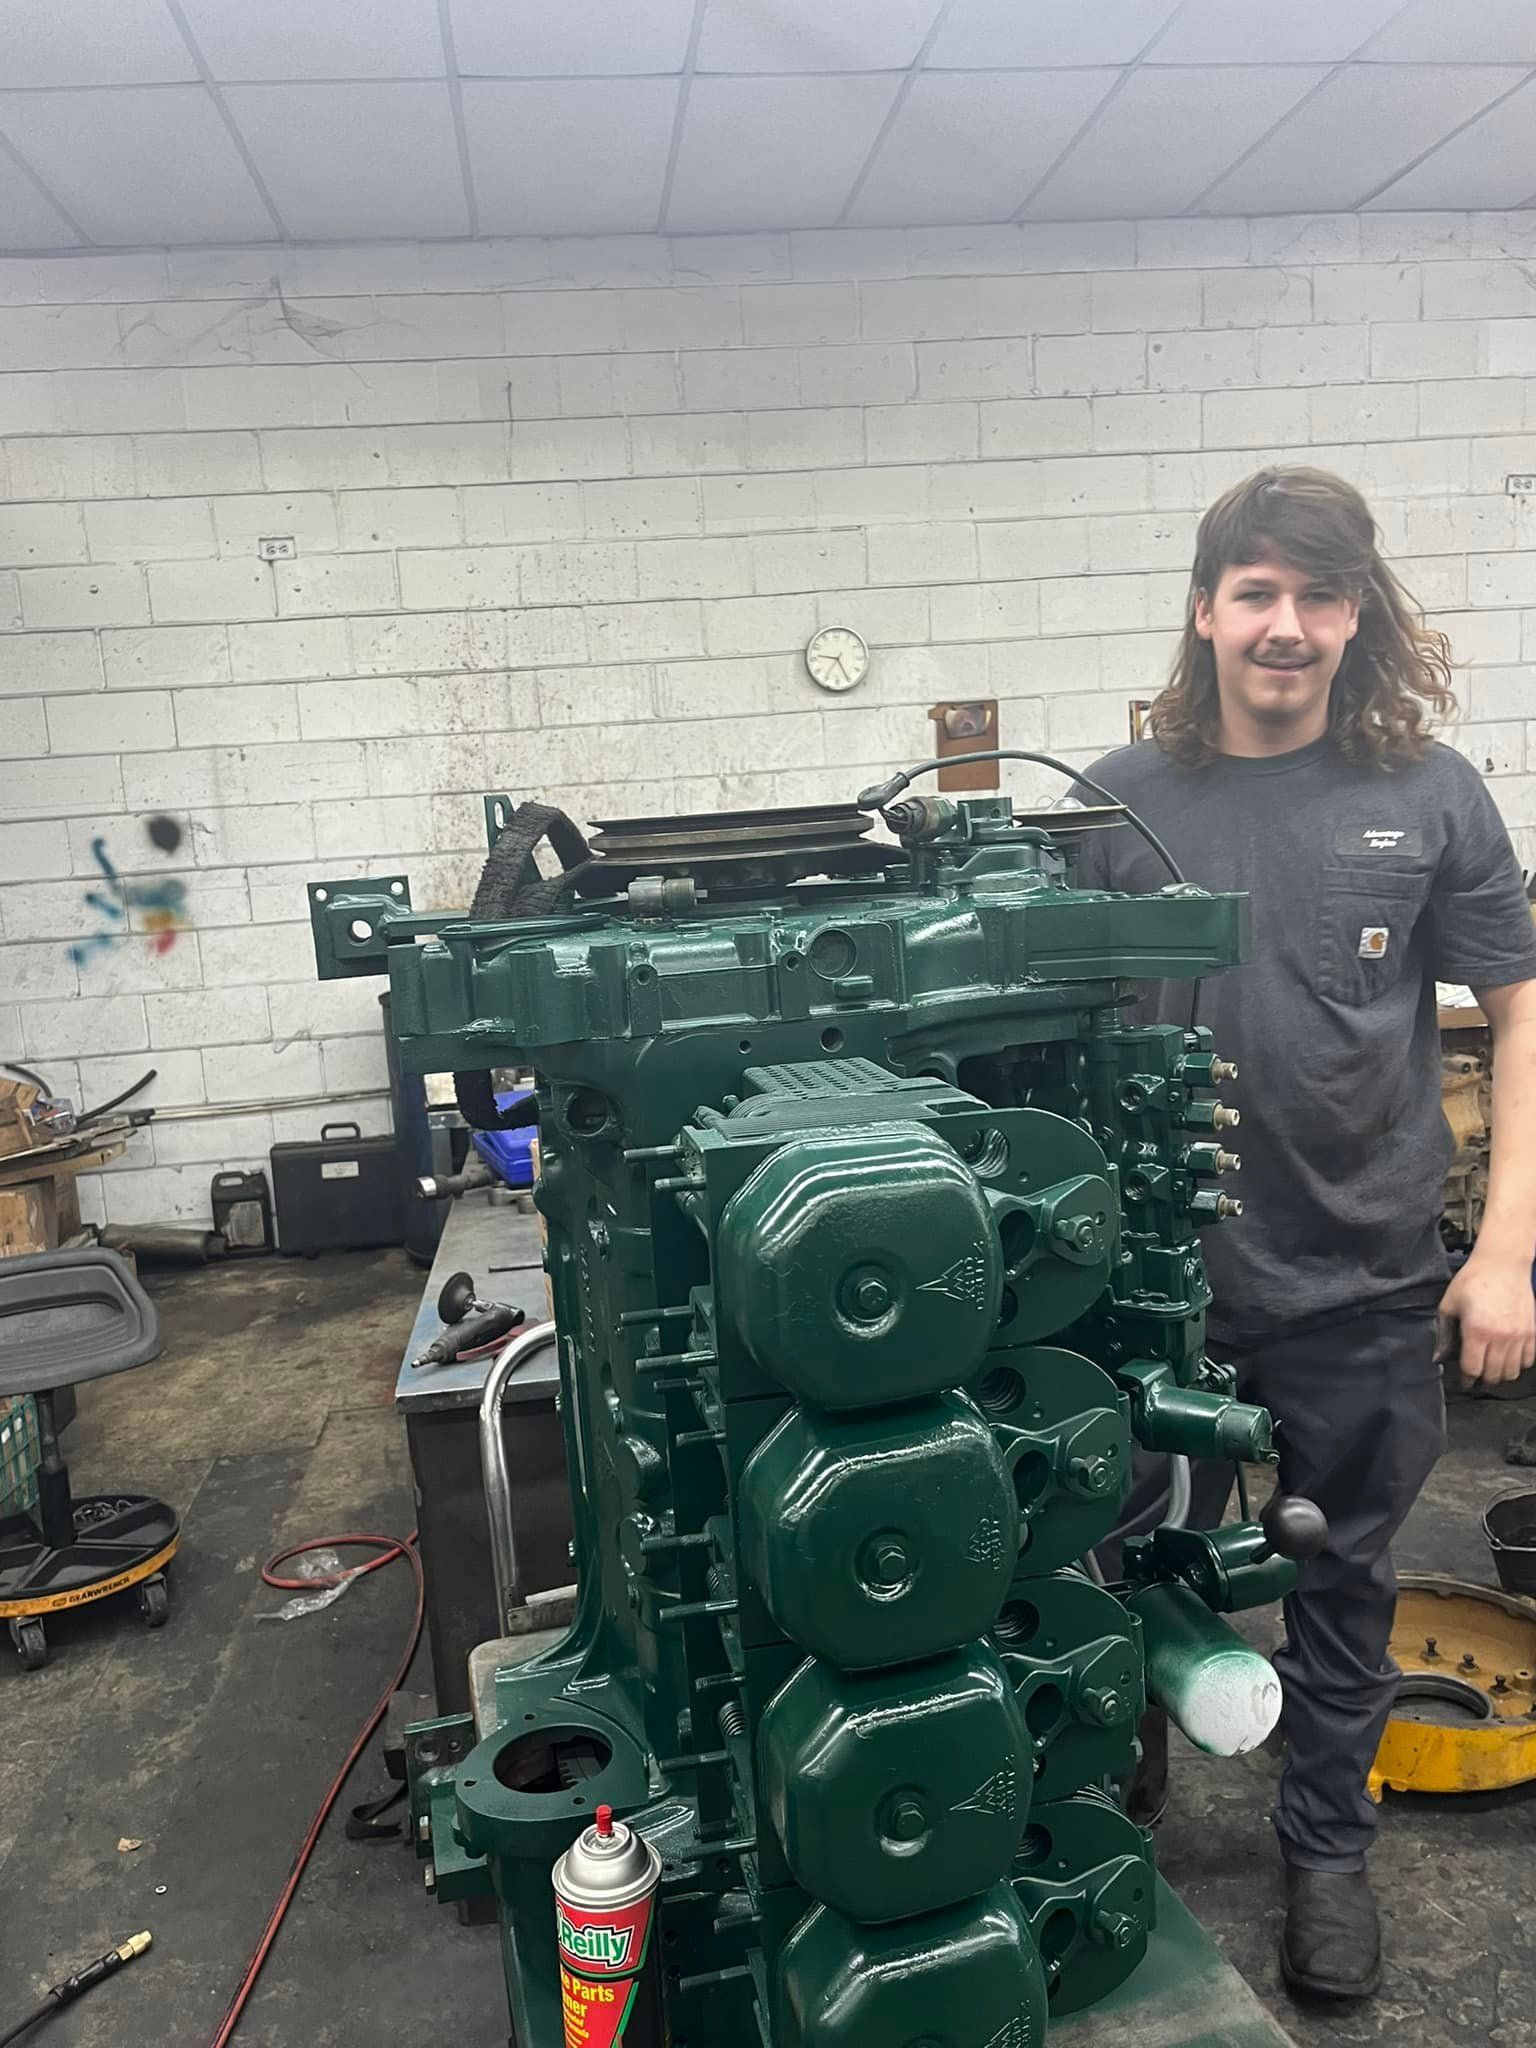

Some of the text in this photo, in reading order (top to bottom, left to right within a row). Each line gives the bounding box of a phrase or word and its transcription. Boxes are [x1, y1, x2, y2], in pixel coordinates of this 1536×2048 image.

[69, 1576, 130, 1603] GEARWRENCH
[560, 1920, 627, 1963] Reilly
[572, 1978, 615, 2002] Parts
